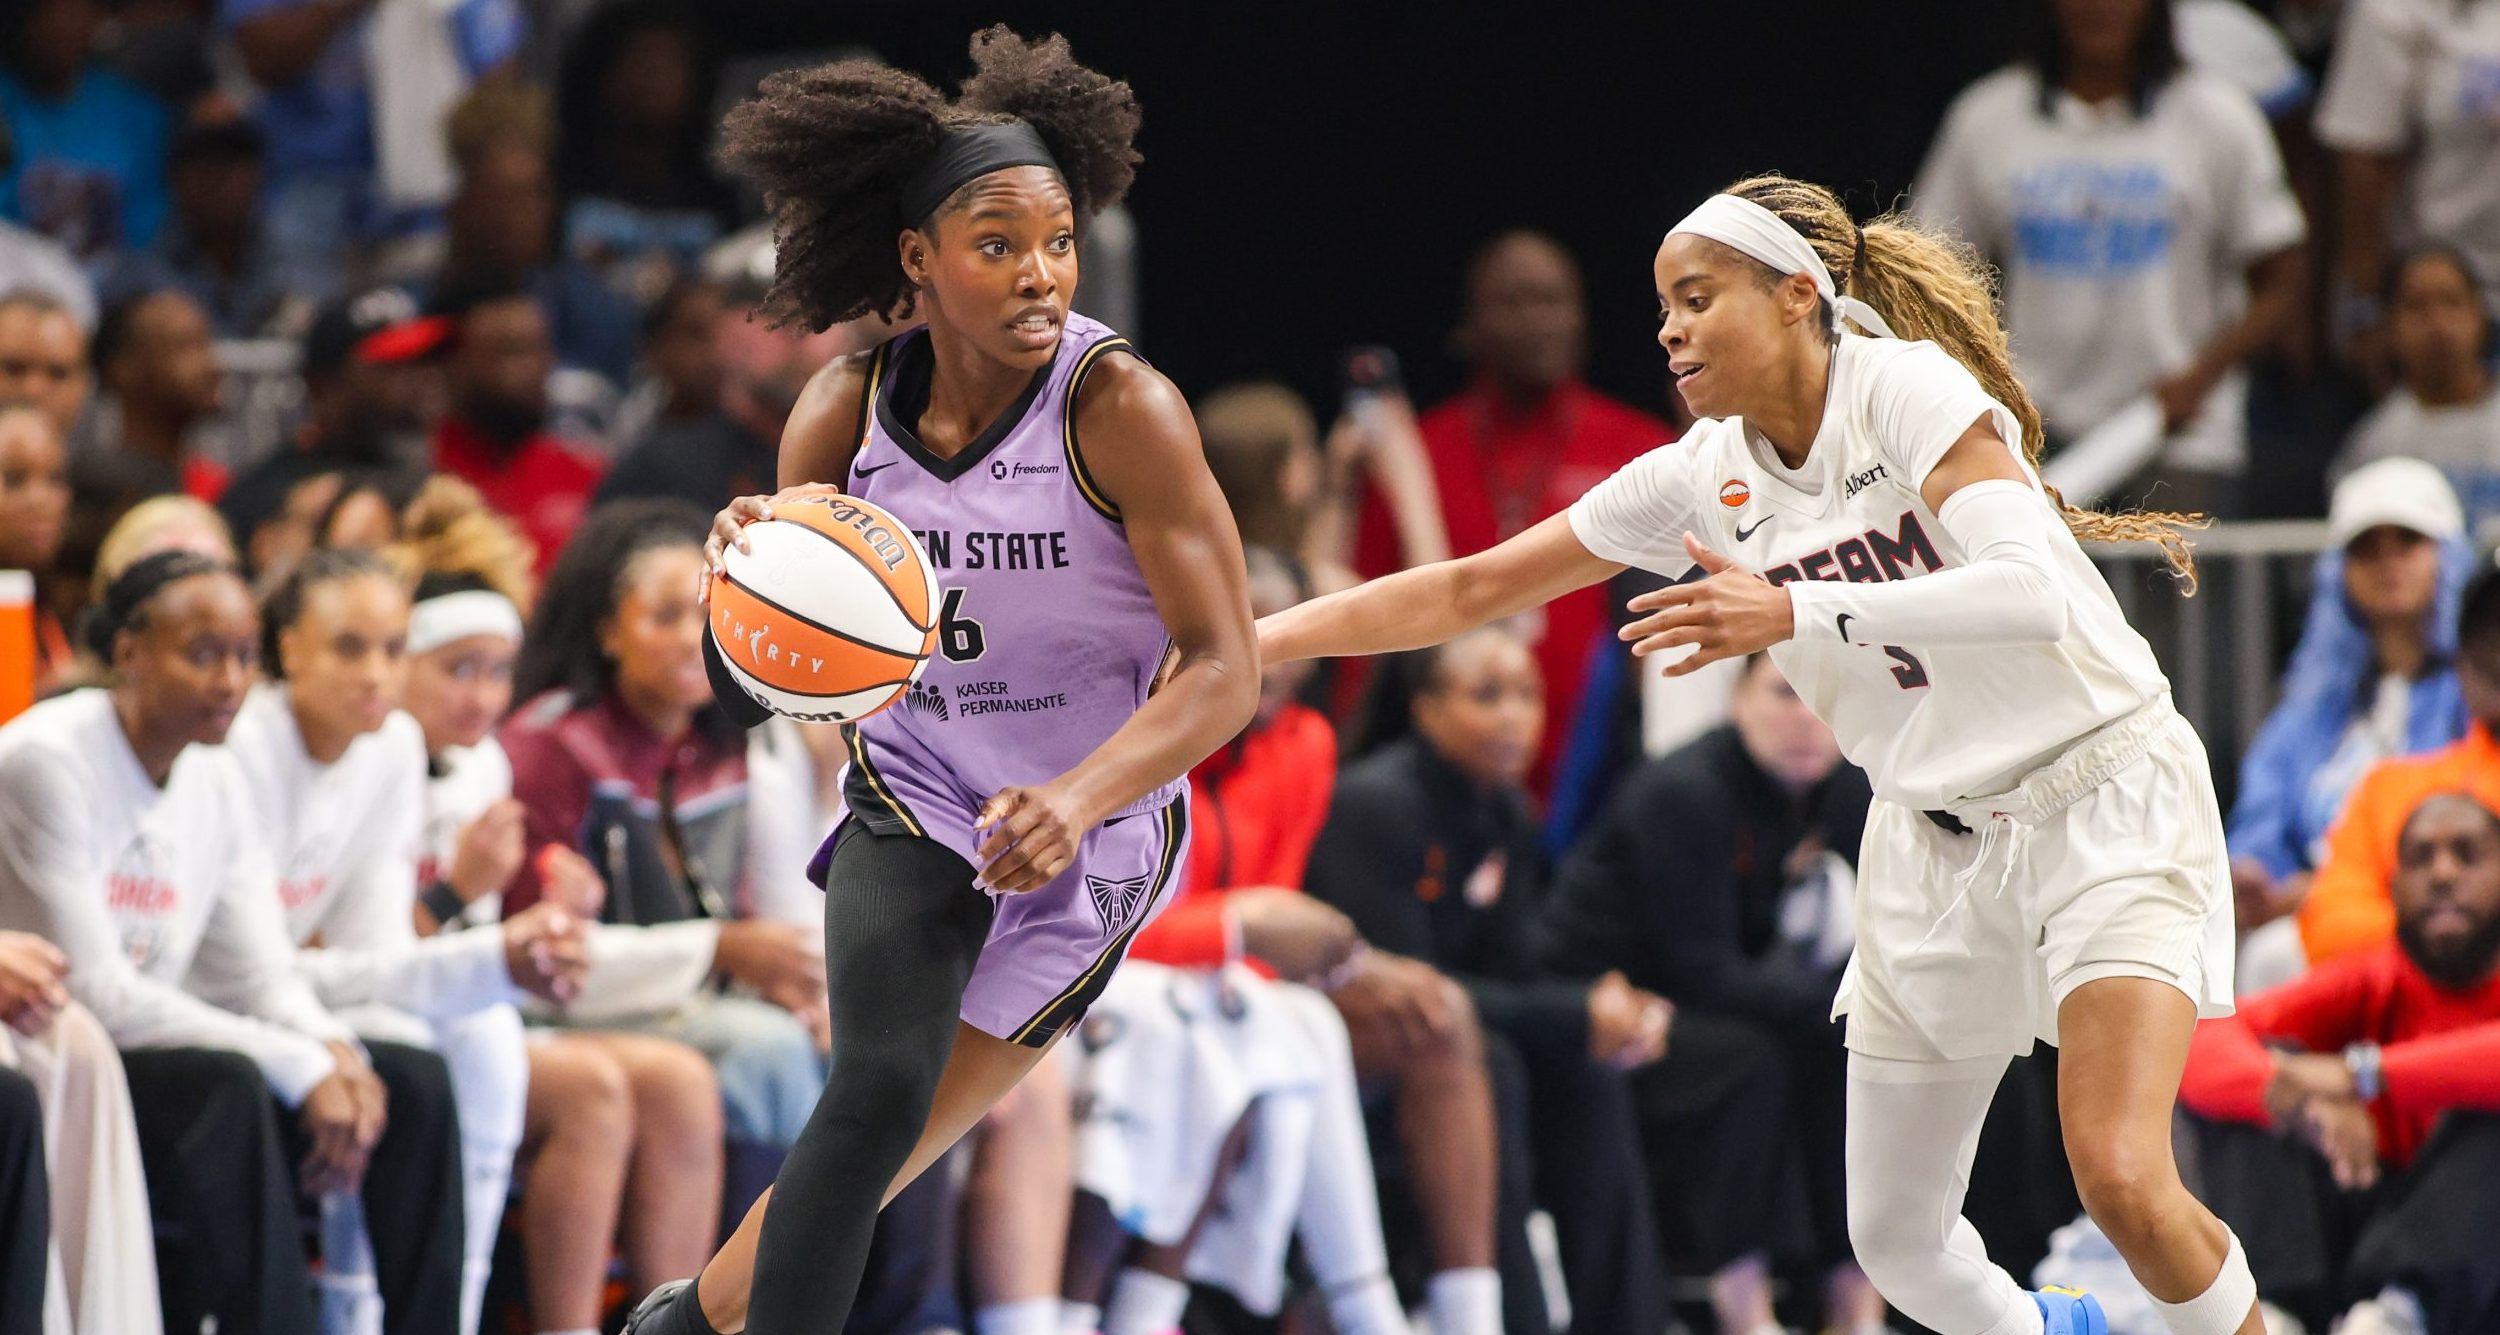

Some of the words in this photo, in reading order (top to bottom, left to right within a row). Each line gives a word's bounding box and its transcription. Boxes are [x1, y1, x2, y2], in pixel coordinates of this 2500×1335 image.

[1011, 462, 1060, 479] freedom
[1844, 462, 1889, 500] Albert
[966, 531, 1070, 571] STATE
[938, 586, 988, 666] 6
[956, 681, 1009, 699] KAISER
[959, 692, 1068, 718] PERMANENTE
